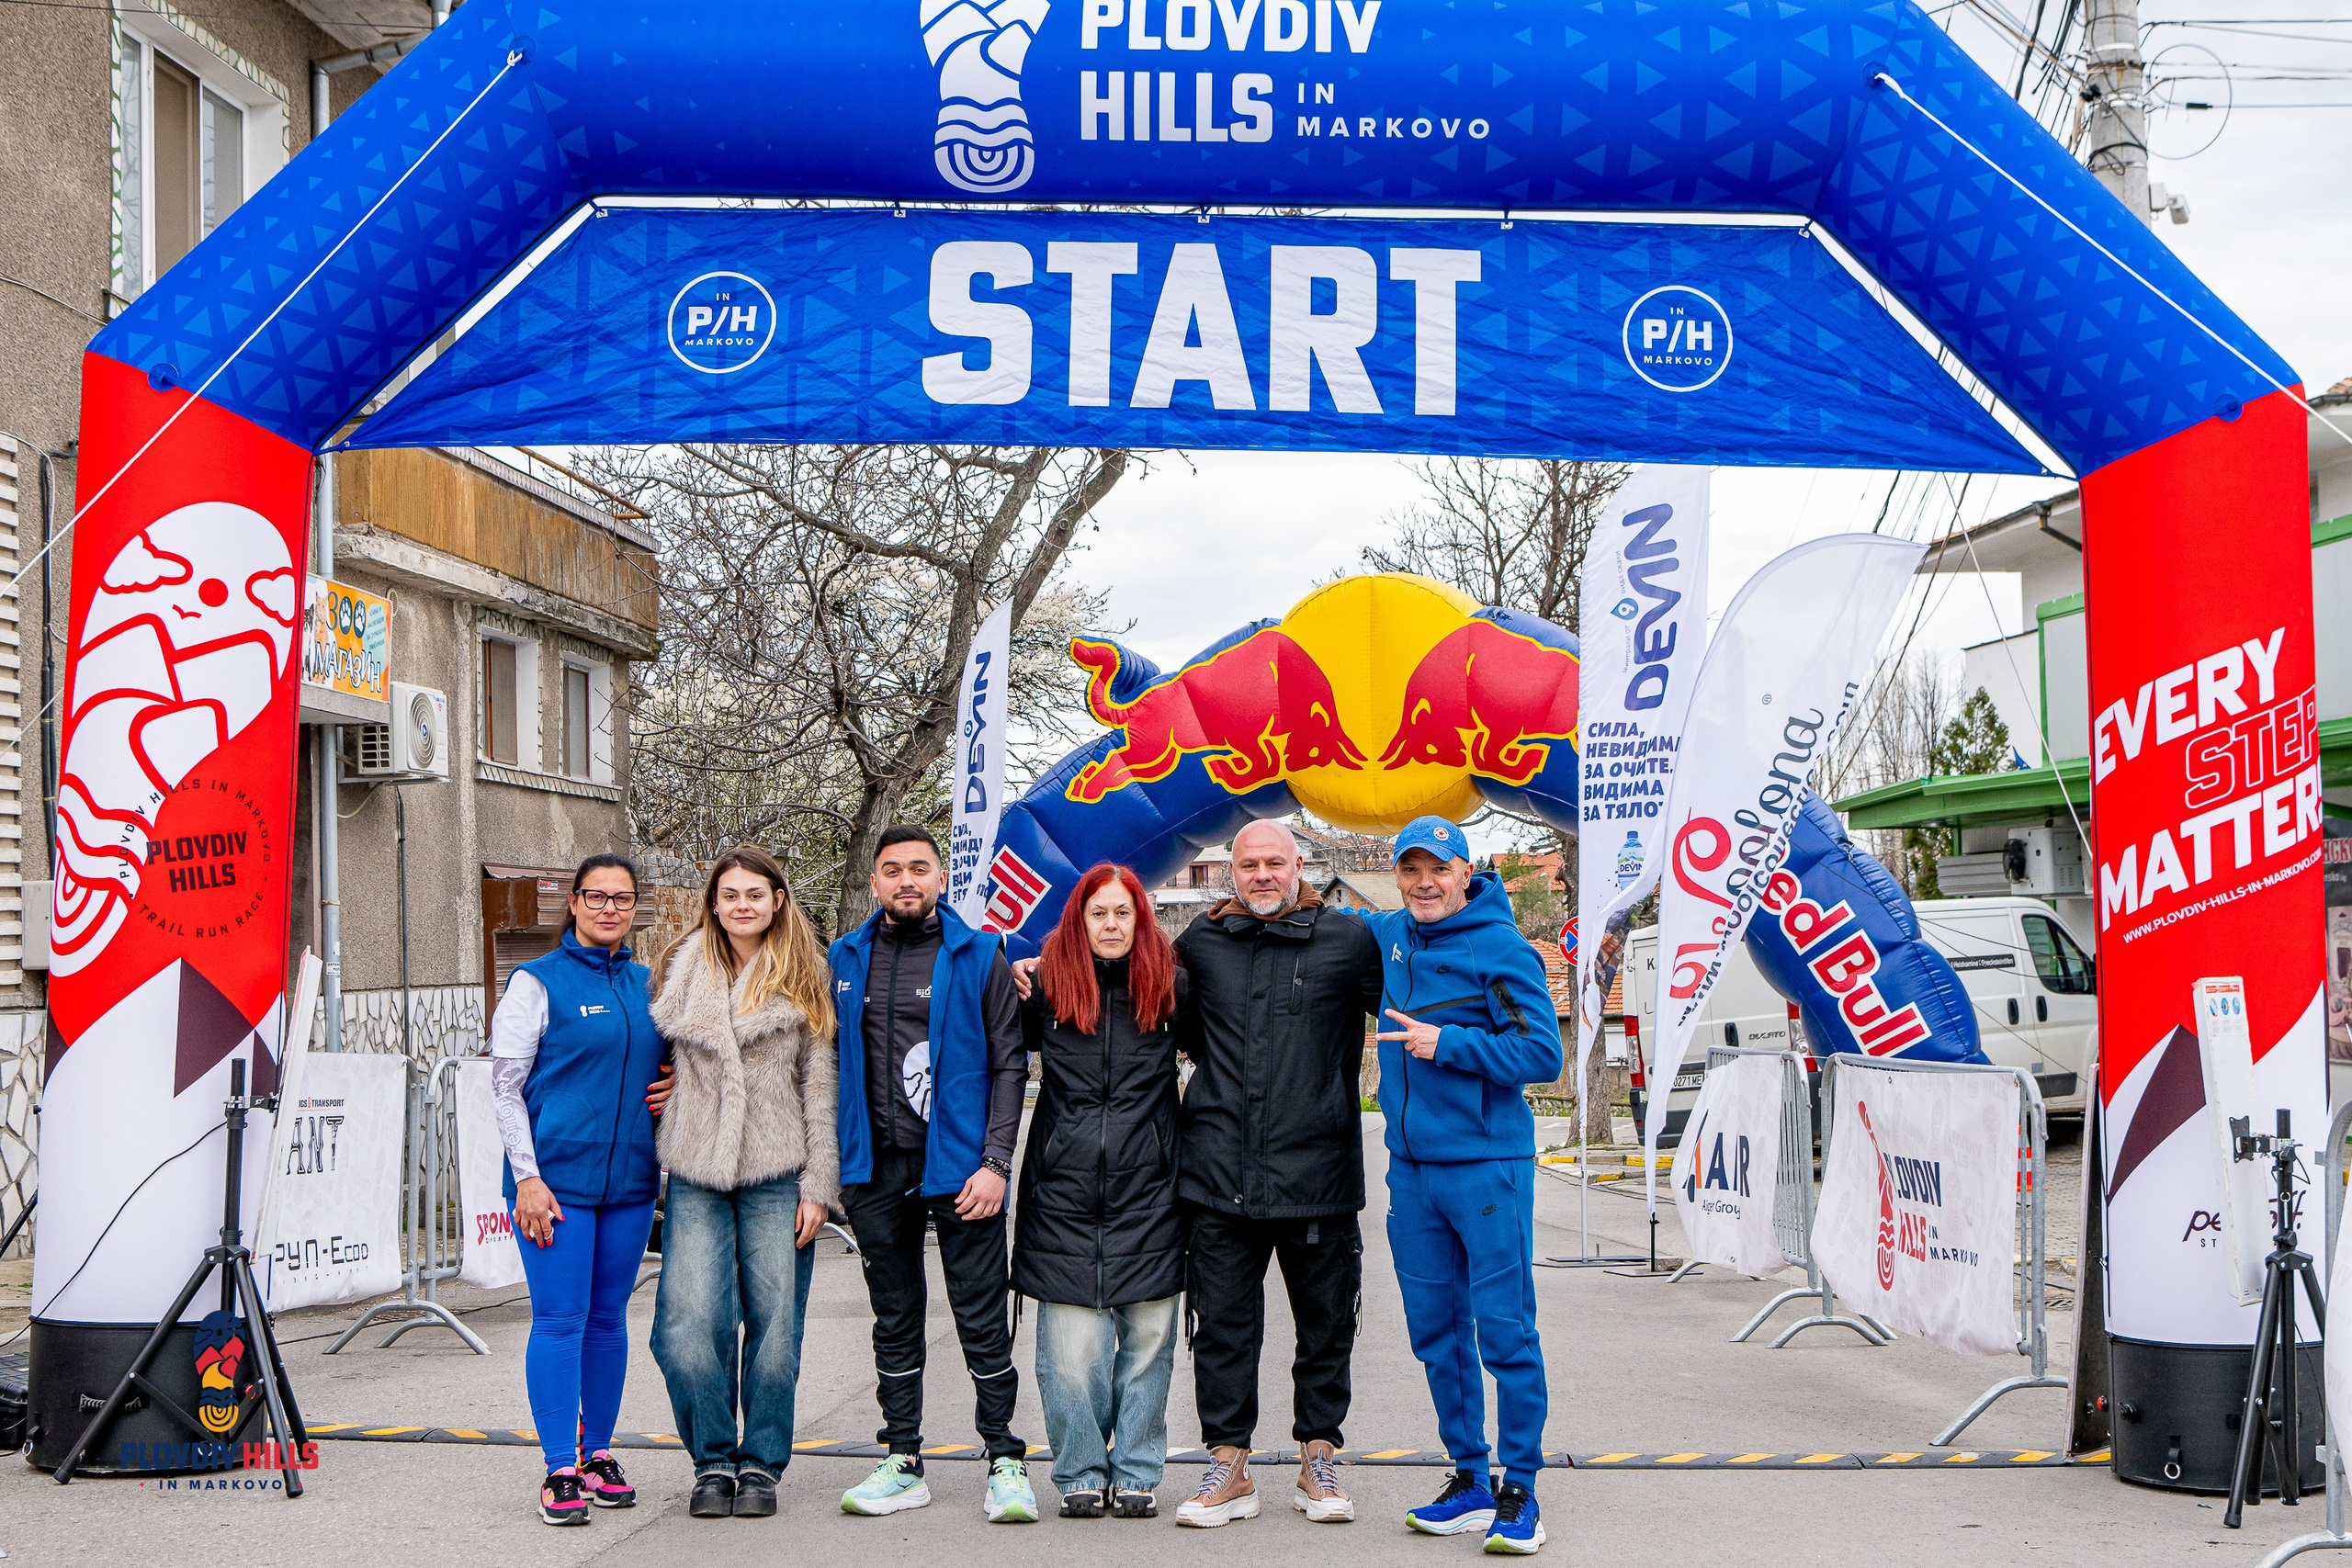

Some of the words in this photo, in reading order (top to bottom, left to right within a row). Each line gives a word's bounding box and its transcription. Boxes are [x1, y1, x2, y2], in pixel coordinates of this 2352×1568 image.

[1081, 0, 1380, 52] PLOVDIV
[1081, 71, 1272, 142] HILLS
[1298, 83, 1334, 104] IN
[1297, 117, 1489, 139] MARKOVO
[716, 293, 730, 301] IN
[1670, 307, 1684, 315] IN
[687, 306, 758, 335] P/H
[922, 241, 1481, 416] START
[1643, 319, 1713, 353] P/H
[684, 337, 754, 346] MARKOVO
[1644, 355, 1713, 366] MARKOVO
[1622, 503, 1681, 711] DEVIN
[315, 641, 382, 693] МАГАЗИН
[2094, 626, 2286, 785] EVERY
[1589, 722, 1645, 738] СИЛА,
[2185, 683, 2319, 809] STEP
[1585, 763, 1604, 779] ЗА
[1584, 780, 1664, 801] ВИДИМА
[150, 779, 200, 804] HILLS
[211, 780, 229, 793] IN
[235, 790, 271, 862] MARKOVO
[1584, 805, 1600, 821] ЗА
[146, 831, 247, 864] PLOVDIV
[169, 863, 236, 892] HILLS
[139, 904, 184, 936] TRAIL
[196, 924, 229, 938] RUN
[236, 892, 264, 927] RACE
[1760, 863, 1849, 949] ed
[1813, 935, 1927, 1056] Bull
[311, 1099, 345, 1108] TRANSPORT
[286, 1115, 345, 1175] ANT
[476, 1212, 514, 1247] SPON
[1929, 1225, 1939, 1240] IN
